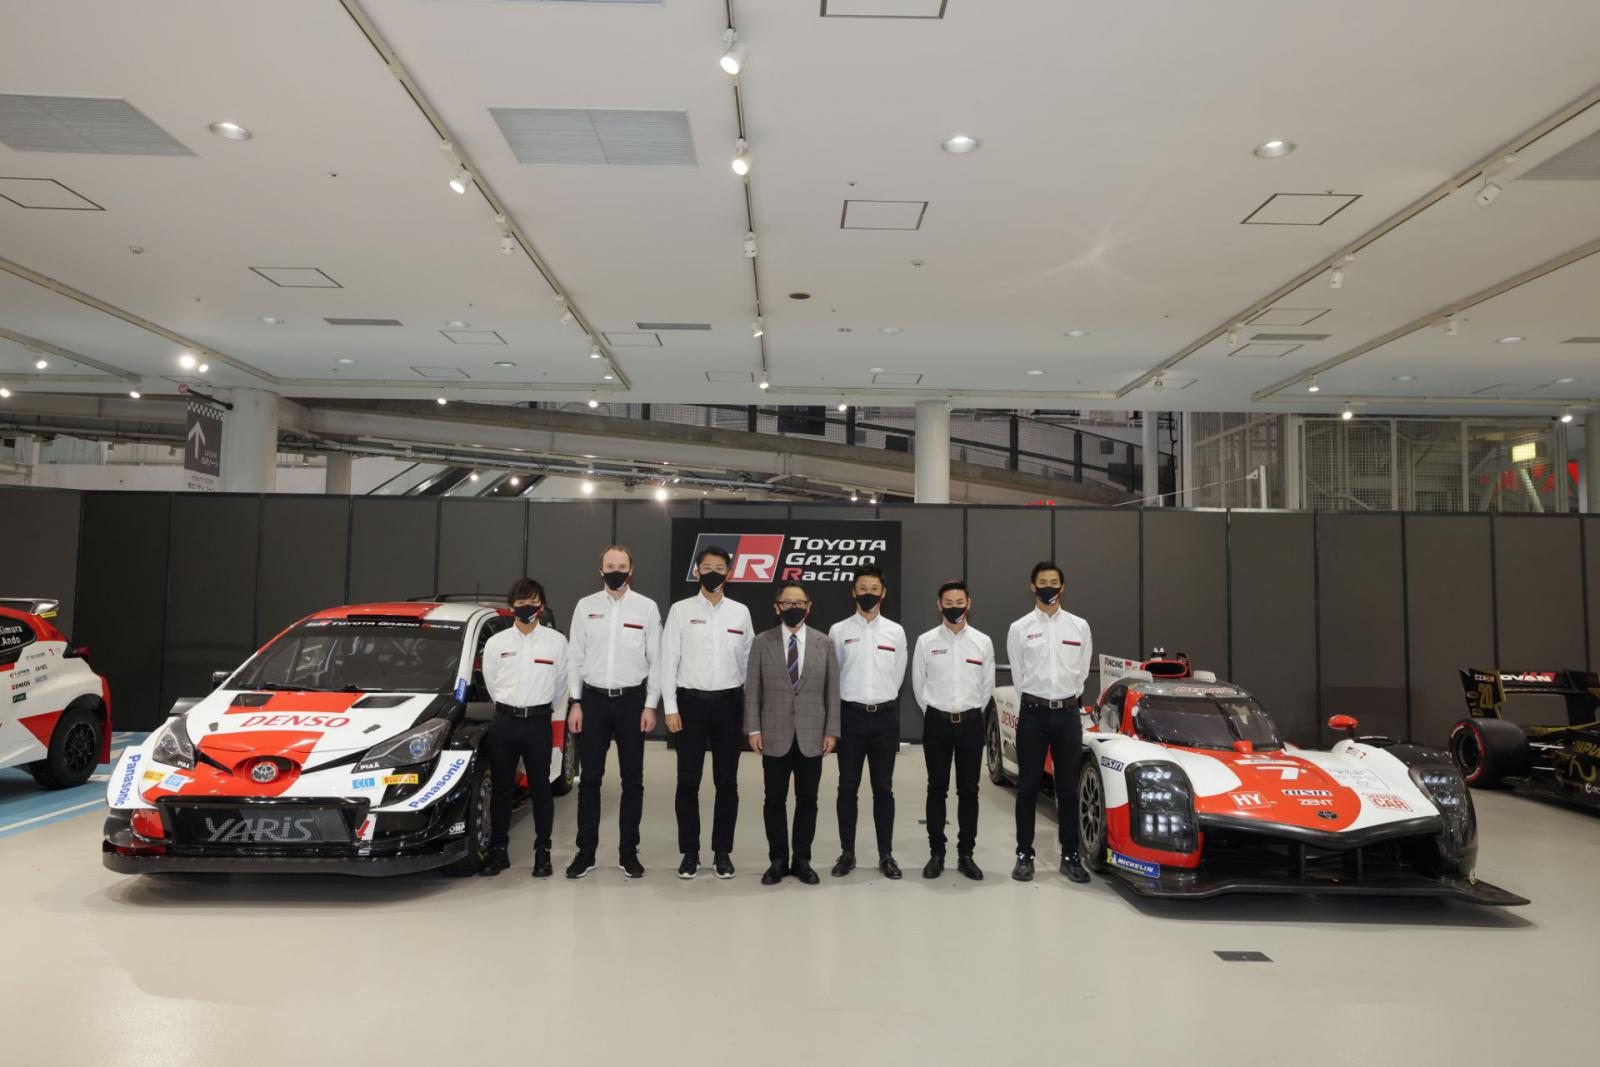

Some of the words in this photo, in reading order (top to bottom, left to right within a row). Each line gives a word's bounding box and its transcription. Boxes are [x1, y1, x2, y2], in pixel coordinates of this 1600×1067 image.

[790, 536, 886, 551] TOYOTA
[692, 554, 775, 579] R
[785, 552, 876, 567] GAZOO
[781, 567, 855, 582] Racin
[1500, 673, 1553, 682] DVAN
[240, 715, 351, 728] DENSO
[360, 761, 380, 770] PIAA
[114, 753, 142, 807] Panasonic
[408, 757, 466, 809] Panasonic
[1117, 857, 1154, 873] MICHELIN
